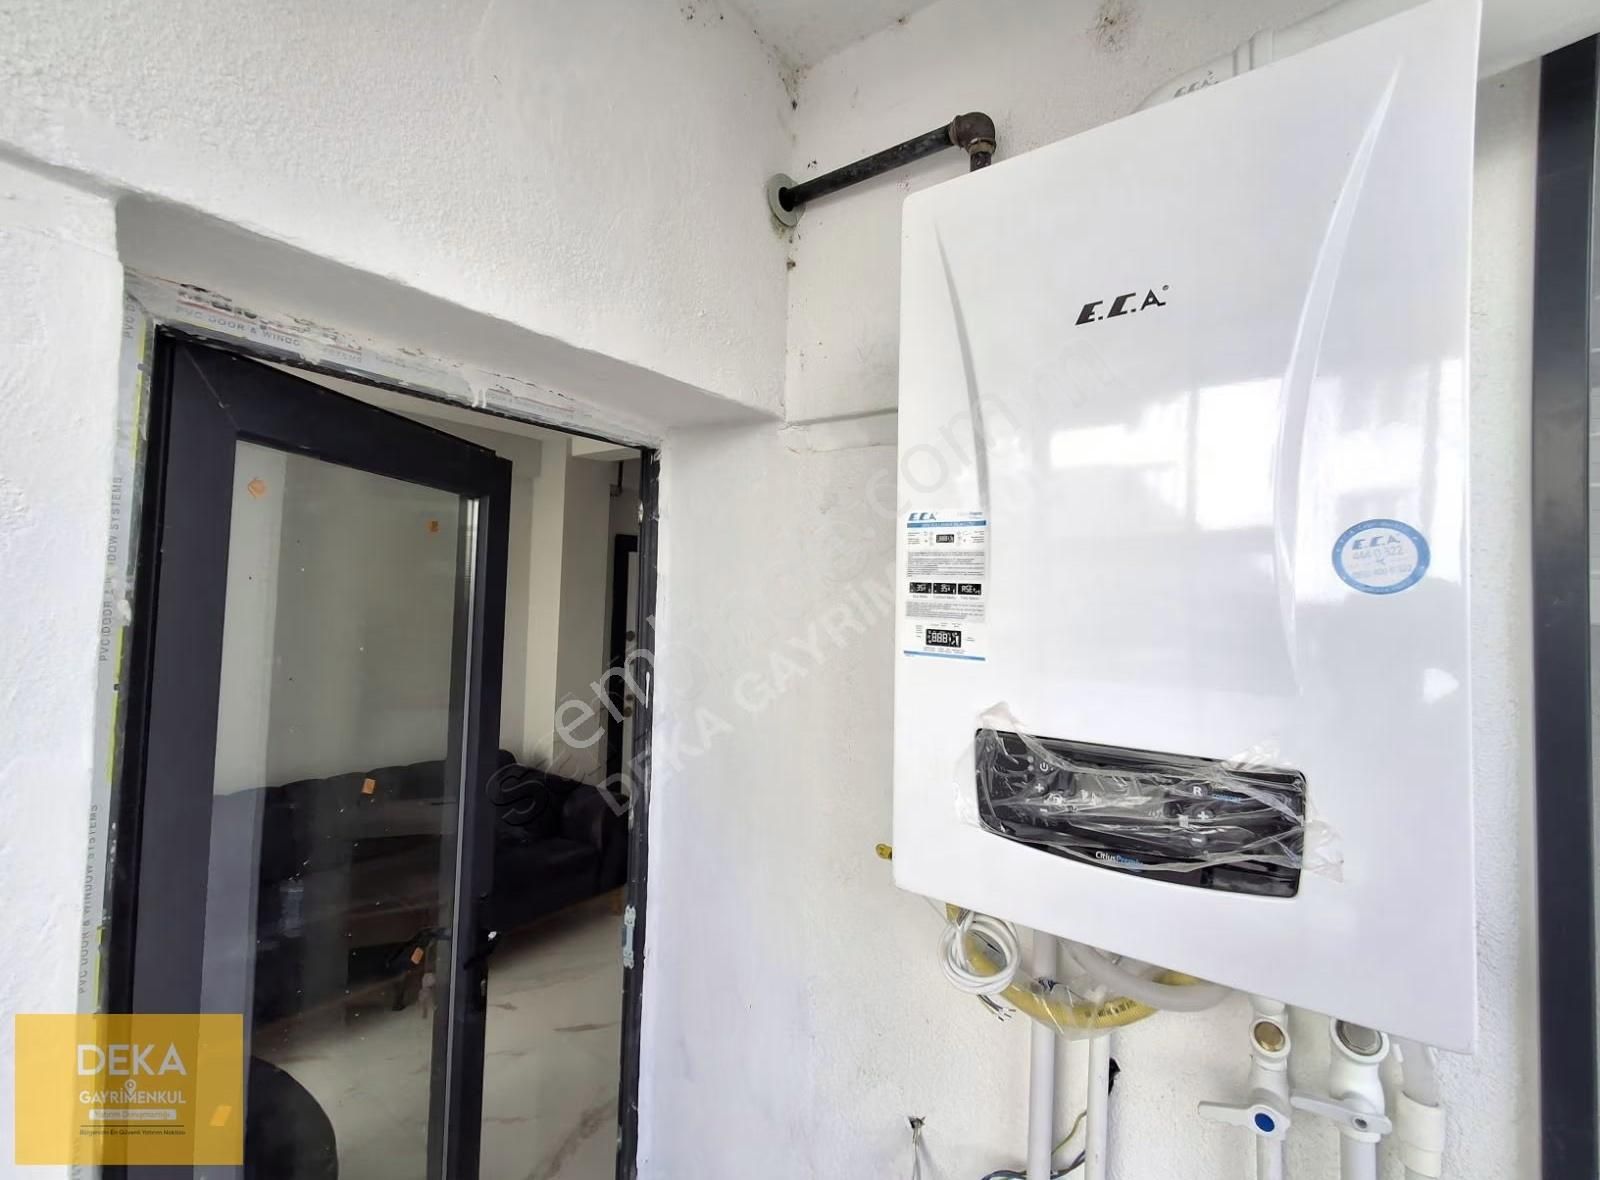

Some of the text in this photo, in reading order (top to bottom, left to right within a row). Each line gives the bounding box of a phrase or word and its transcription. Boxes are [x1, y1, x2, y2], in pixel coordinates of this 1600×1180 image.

[261, 329, 301, 347] WINDO
[110, 477, 122, 530] SYSTEMS
[101, 600, 113, 634] DOOR
[99, 636, 111, 661] PVC
